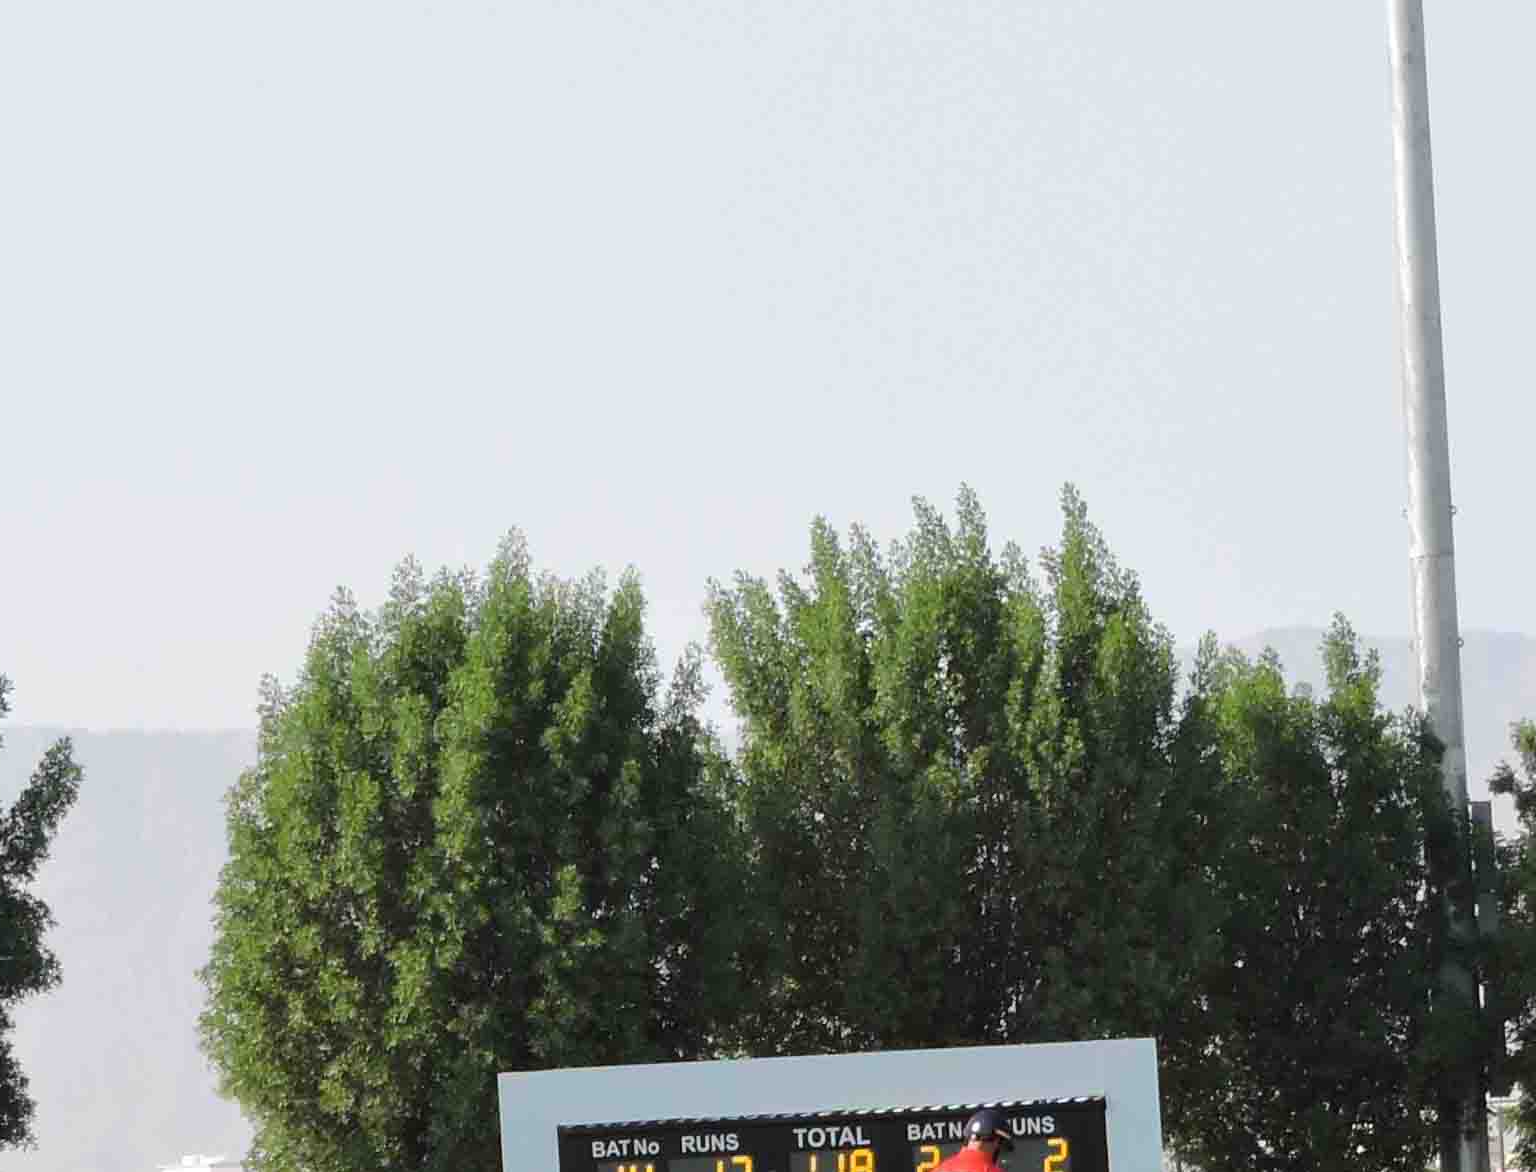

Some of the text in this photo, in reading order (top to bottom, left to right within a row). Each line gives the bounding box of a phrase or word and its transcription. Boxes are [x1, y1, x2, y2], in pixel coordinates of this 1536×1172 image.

[907, 1121, 946, 1141] BAT
[1007, 1114, 1056, 1136] UNS
[681, 1133, 740, 1153] RUNS
[793, 1126, 871, 1149] TOTAL
[591, 1139, 631, 1158] BAT
